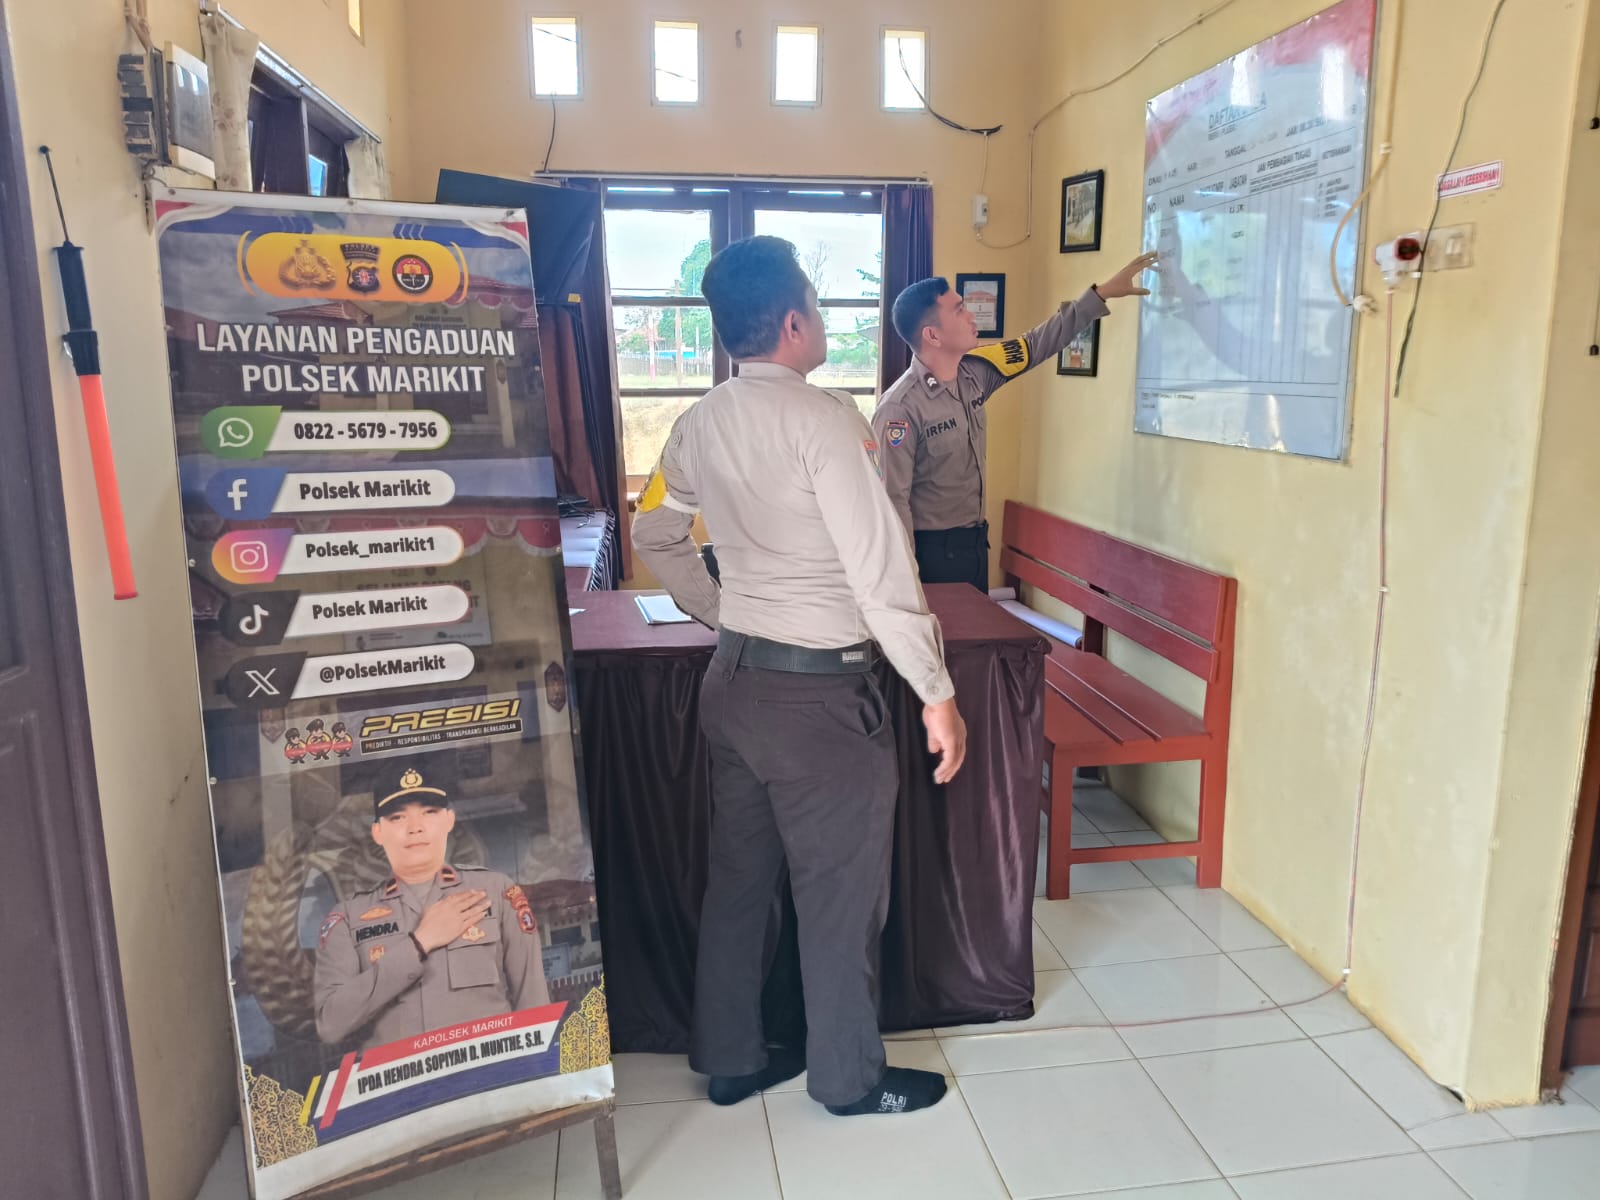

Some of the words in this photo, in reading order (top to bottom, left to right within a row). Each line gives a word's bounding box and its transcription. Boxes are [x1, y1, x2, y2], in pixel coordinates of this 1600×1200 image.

[197, 322, 338, 353] LAYANAN
[347, 326, 515, 356] PENGADUAN
[242, 364, 359, 393] POLSEK
[367, 365, 484, 393] MARIKIT
[294, 422, 334, 440] 0822
[347, 422, 387, 439] 5679
[399, 421, 438, 439] 7956
[926, 418, 957, 438] IRFAN
[300, 482, 361, 500] Polsek
[364, 479, 431, 498] Marikit
[305, 537, 436, 558] Polsek_marikit1
[312, 601, 366, 620] Polsek
[369, 595, 428, 614] Marikit
[319, 655, 446, 683] @PolsekMarikit
[356, 922, 399, 942] HENDRA
[413, 1027, 470, 1050] KAPOLSEK
[471, 1016, 513, 1034] MARIKIT
[357, 1072, 383, 1095] IPDA
[384, 1059, 424, 1087] HENDRA
[425, 1046, 468, 1074] SOPIYAN
[469, 1044, 480, 1061] D.
[480, 1034, 524, 1058] MUNTHE,
[525, 1030, 544, 1048] S.H.
[881, 1091, 907, 1107] POLRI
